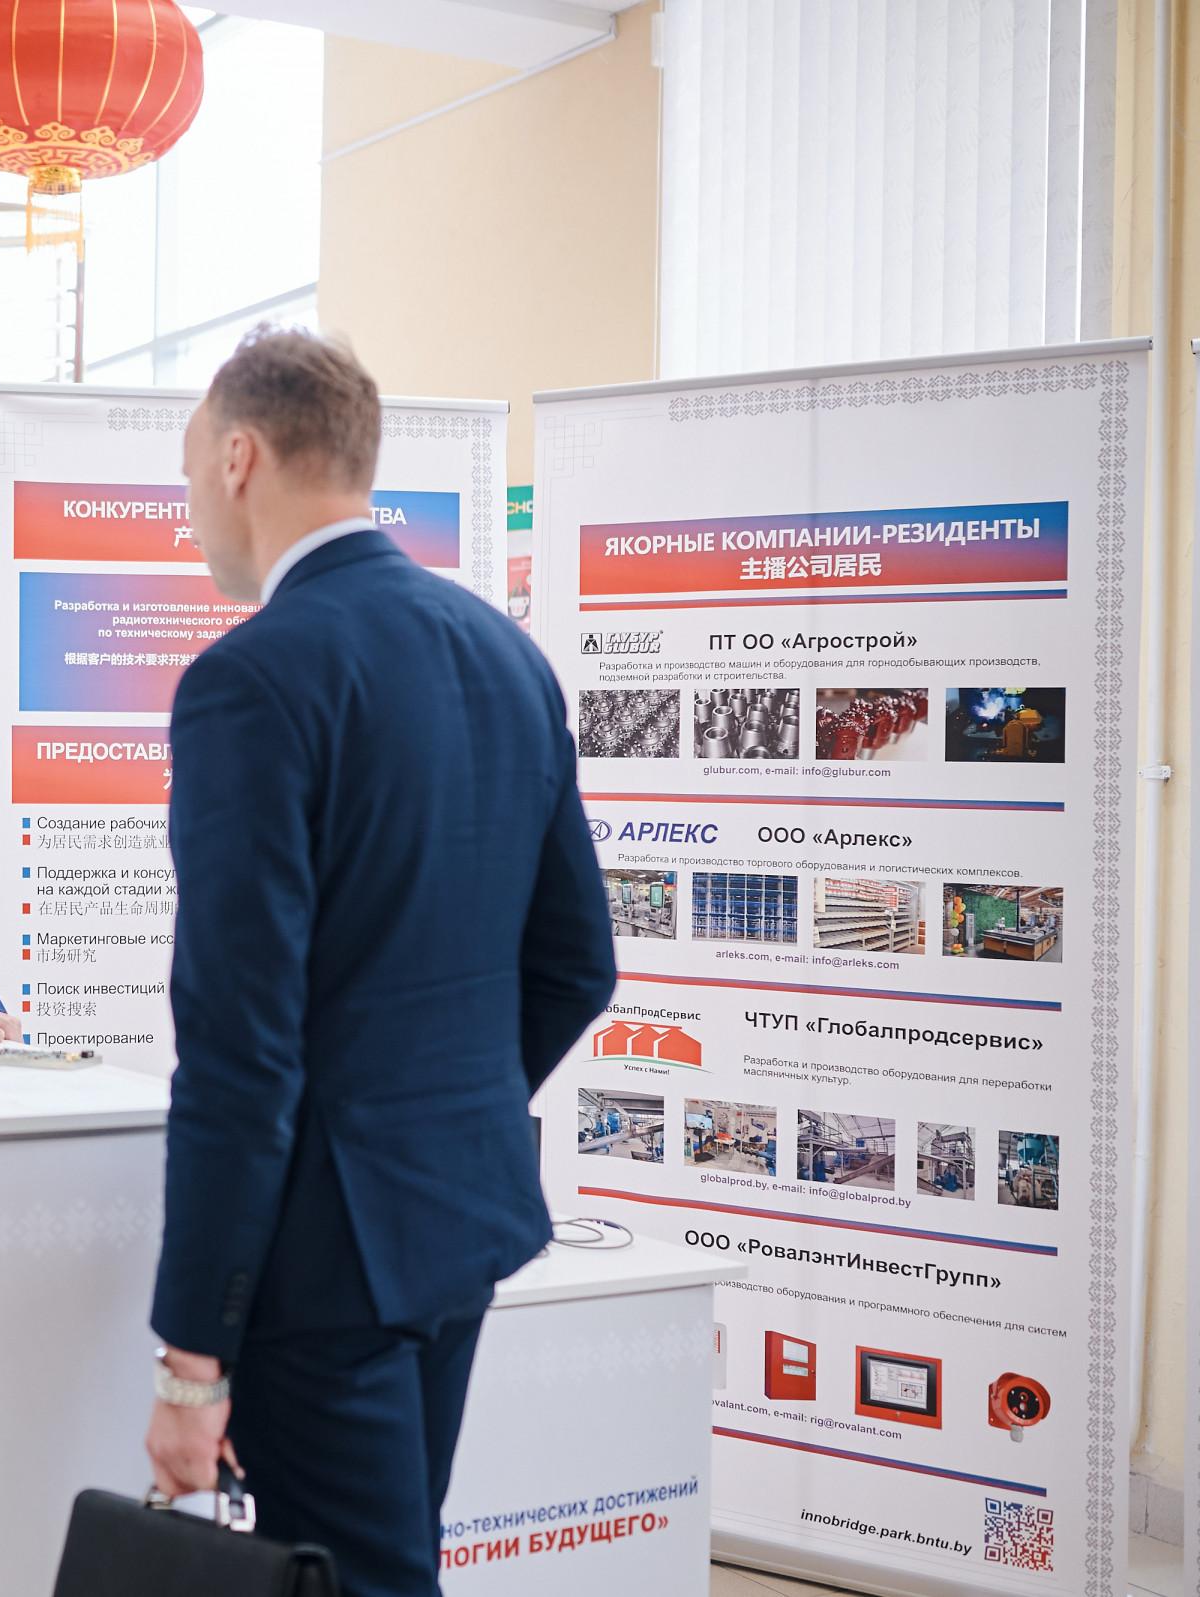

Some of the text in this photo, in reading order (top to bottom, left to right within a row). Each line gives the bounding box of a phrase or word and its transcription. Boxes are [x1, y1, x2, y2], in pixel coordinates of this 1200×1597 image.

[603, 517, 1040, 557] ЯКОРНЫЕ КОМПАНИИ-РЕЗИДЕНТЫ
[739, 553, 883, 582] 主播公司居民
[54, 600, 120, 613] Разработка
[122, 603, 130, 612] и
[132, 603, 210, 613] изготовление
[112, 616, 223, 626] радиотехнического
[98, 630, 113, 638] по
[115, 630, 194, 640] техническому
[708, 631, 917, 653] ПТ ОО «Агрострой»
[598, 661, 654, 672] Разработка
[663, 661, 726, 671] производство
[727, 661, 762, 669] машин
[772, 658, 844, 670] оборудования
[844, 660, 865, 669] для
[867, 657, 966, 669] горнодобывающих
[967, 658, 1041, 668] производств,
[598, 672, 650, 682] подземной
[651, 671, 703, 683] разработки
[712, 671, 786, 683] строительства.
[38, 743, 172, 763] ПРЕДОСТАВЛ
[702, 765, 891, 778] glubur.com, e-mail: info@glubur.com
[37, 816, 167, 831] Создание рабочих
[616, 821, 719, 844] АРЛЕКС
[756, 826, 913, 850] ООО «Арлекс»
[37, 866, 117, 881] Поддержка
[121, 869, 130, 879] и
[617, 853, 670, 864] Разработка
[678, 857, 745, 867] производство
[746, 859, 793, 869] торгового
[794, 859, 867, 872] оборудования
[868, 864, 876, 872] и
[877, 865, 954, 875] логистических
[955, 868, 1023, 878] комплексов.
[37, 885, 54, 896] на
[58, 883, 110, 897] каждой
[114, 885, 163, 897] стадии
[39, 900, 175, 917] 在居民产品生命周期
[37, 932, 147, 947] Маркетинговые
[36, 948, 97, 963] 市场研究
[714, 950, 900, 970] arleks.com, e-mail: info@arleks.com
[36, 981, 165, 996] Поиск инвестиций
[35, 1001, 97, 1017] 投资搜索
[605, 1004, 702, 1021] обалПродСервис
[36, 1032, 154, 1047] Проектирование
[744, 1011, 1043, 1051] ЧТУП «Глобалпродсервис»
[622, 1064, 643, 1072] Успех
[648, 1067, 670, 1075] Нами!
[742, 1054, 799, 1069] Разработка
[809, 1062, 880, 1076] производство
[881, 1068, 956, 1083] оборудования
[957, 1076, 979, 1086] для
[980, 1078, 1052, 1092] переработки
[742, 1068, 852, 1086] масляничных культур.
[699, 1173, 912, 1209] globalprod.by, e-mail: info@globalprod.by
[683, 1229, 1001, 1289] ООО «РовалэнтИнвестГрупп»
[714, 1281, 774, 1293] оизводство
[775, 1287, 847, 1305] оборудования
[857, 1300, 931, 1318] программного
[931, 1310, 1002, 1328] обеспечения
[1003, 1322, 1025, 1332] для
[1026, 1326, 1067, 1338] систем
[712, 1399, 902, 1440] valant.com, e-mail: rig@rovalant.com
[441, 1476, 698, 1540] но-технических достижений
[439, 1513, 669, 1569] ЛОГИИ БУДУЩЕГО»
[799, 1508, 972, 1556] innobridge.park.bntu.by
